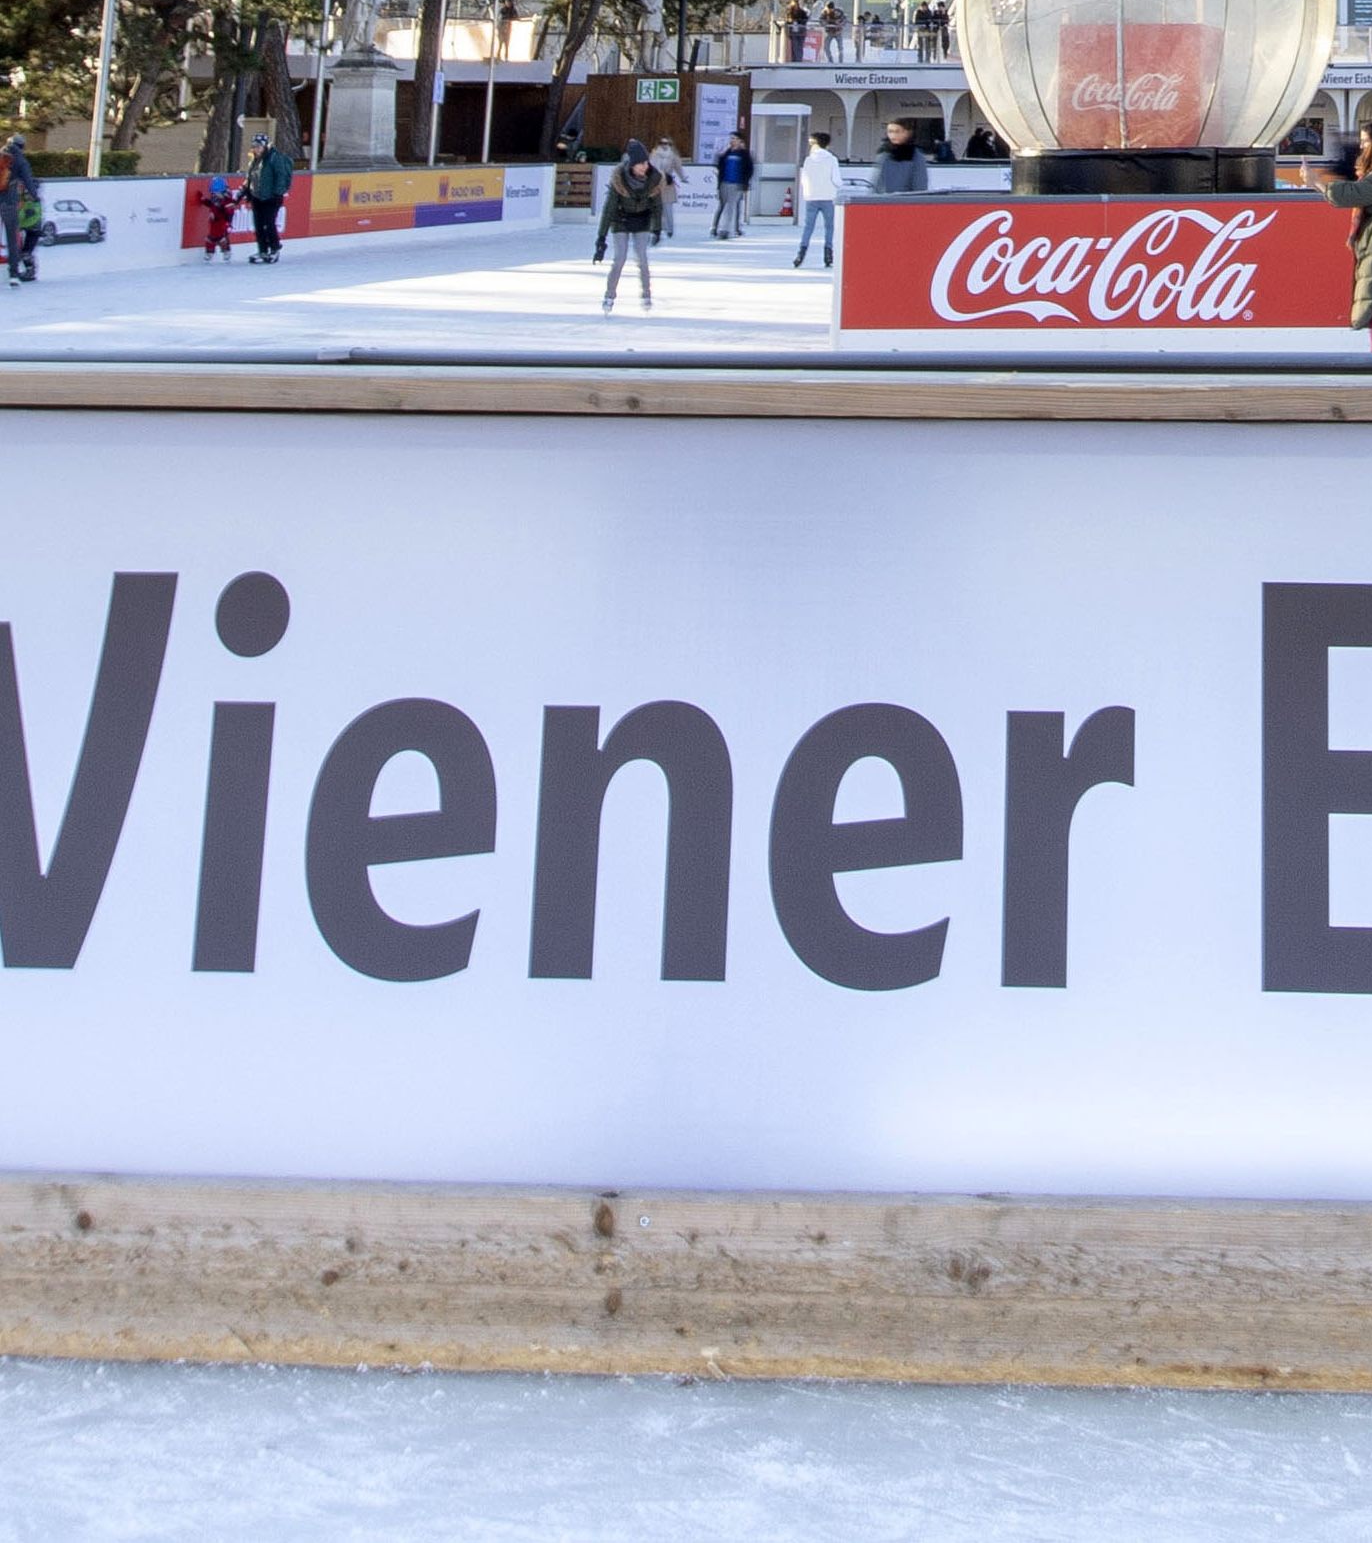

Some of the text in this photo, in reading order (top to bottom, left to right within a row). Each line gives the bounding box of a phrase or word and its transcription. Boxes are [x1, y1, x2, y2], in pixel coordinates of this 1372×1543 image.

[834, 73, 908, 84] Wiener Eistraum
[929, 209, 1278, 323] Coca-Cola
